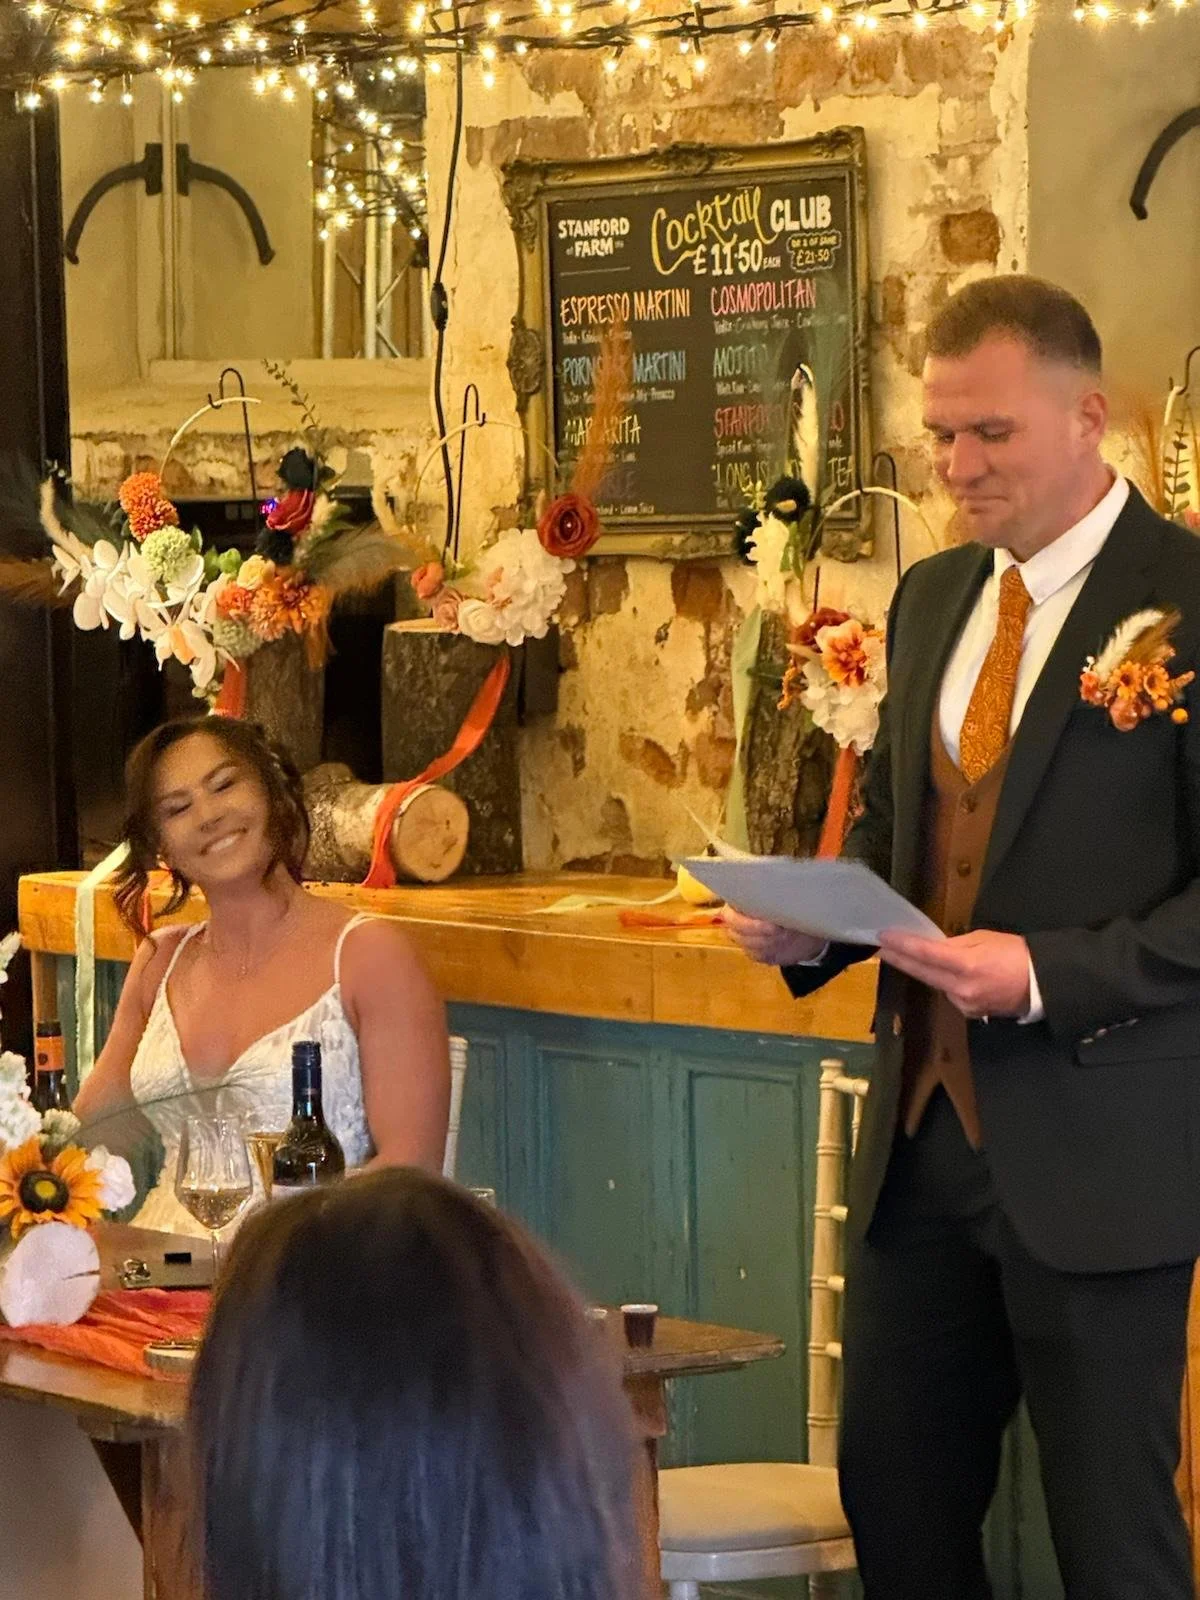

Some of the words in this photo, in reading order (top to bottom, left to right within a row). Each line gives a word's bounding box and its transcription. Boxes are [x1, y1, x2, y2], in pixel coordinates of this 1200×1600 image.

[558, 217, 630, 239] STANFORD
[651, 186, 779, 275] Cocktail
[770, 194, 832, 232] CLUB
[574, 238, 614, 258] FARM
[763, 255, 781, 269] EACH
[560, 292, 630, 326] ESPRESSO
[633, 288, 691, 320] MARTINI
[711, 278, 816, 317] COSMOPOLITAN
[632, 350, 686, 383] MARTINI
[564, 413, 641, 446] MARARITA
